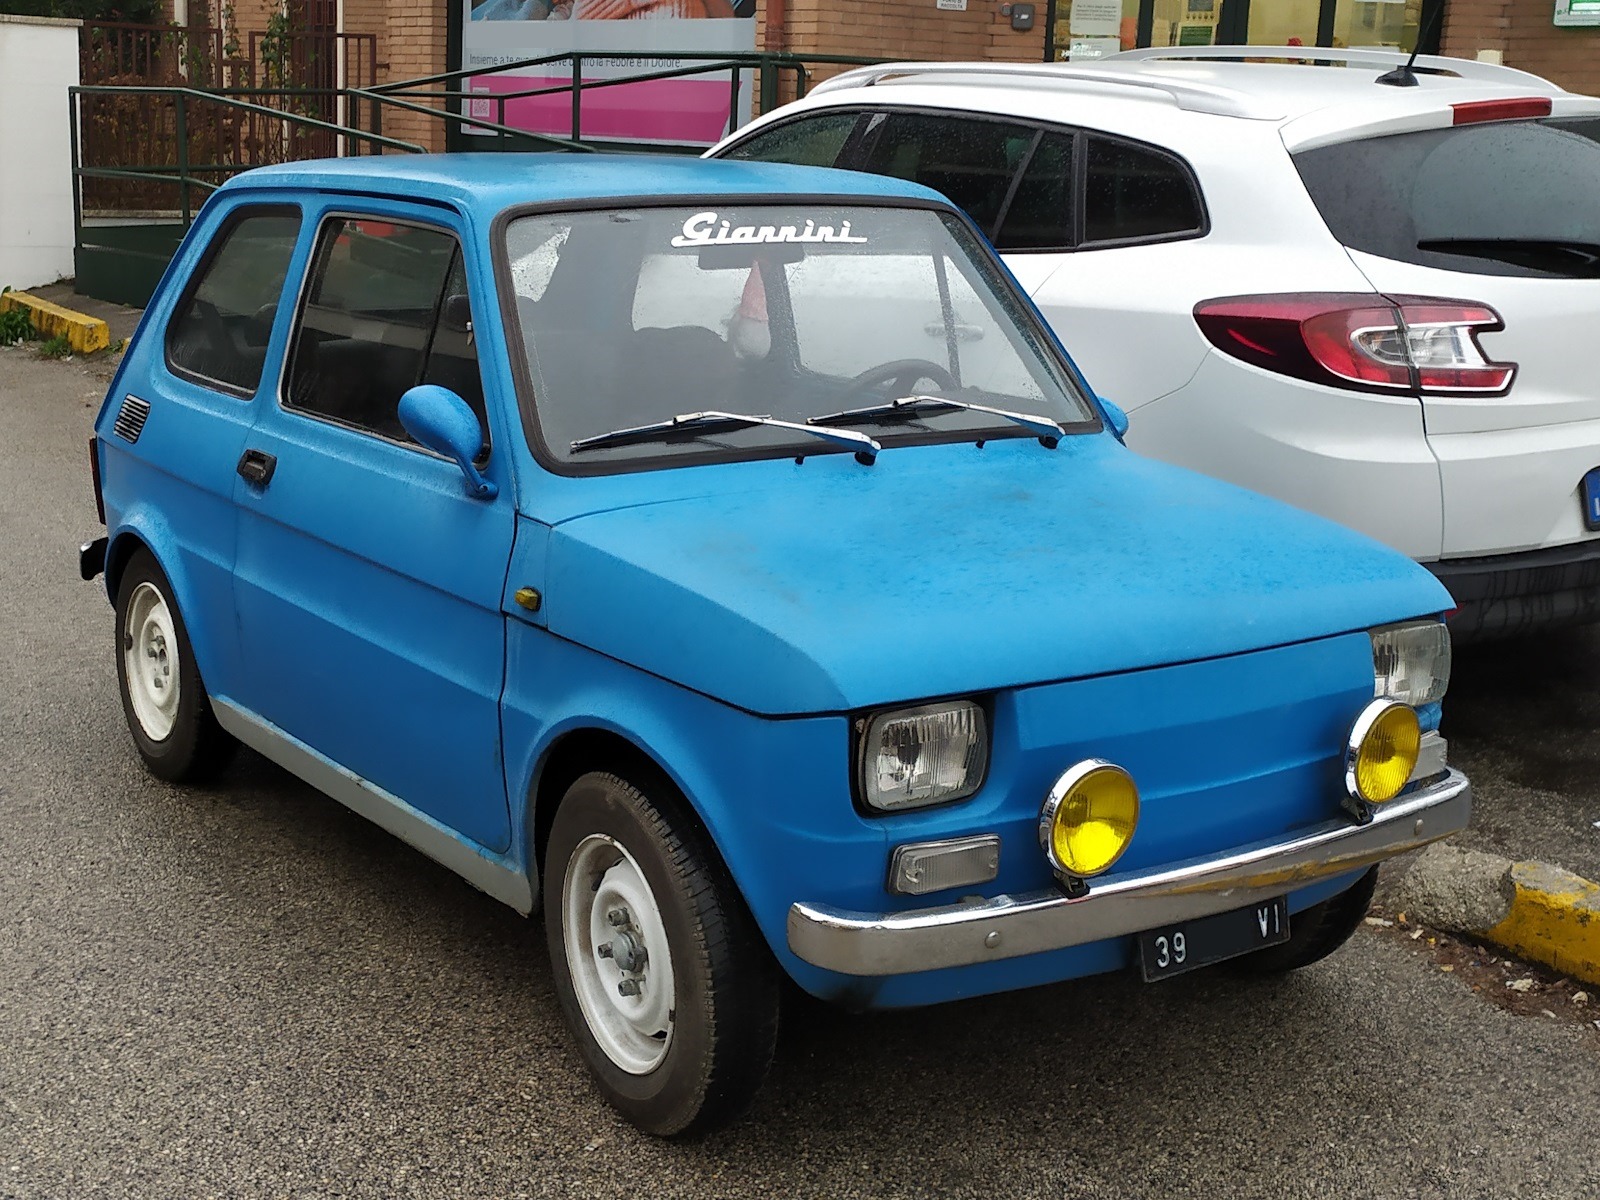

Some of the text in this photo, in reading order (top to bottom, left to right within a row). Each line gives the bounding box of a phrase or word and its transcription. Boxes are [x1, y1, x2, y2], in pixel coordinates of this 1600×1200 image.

[469, 54, 498, 65] Insieme
[596, 57, 603, 67] la
[605, 57, 634, 67] Febbre
[636, 58, 642, 67] e
[651, 58, 683, 68] Dolore.
[671, 211, 867, 248] Giannini
[1155, 903, 1280, 968] 39 VI
